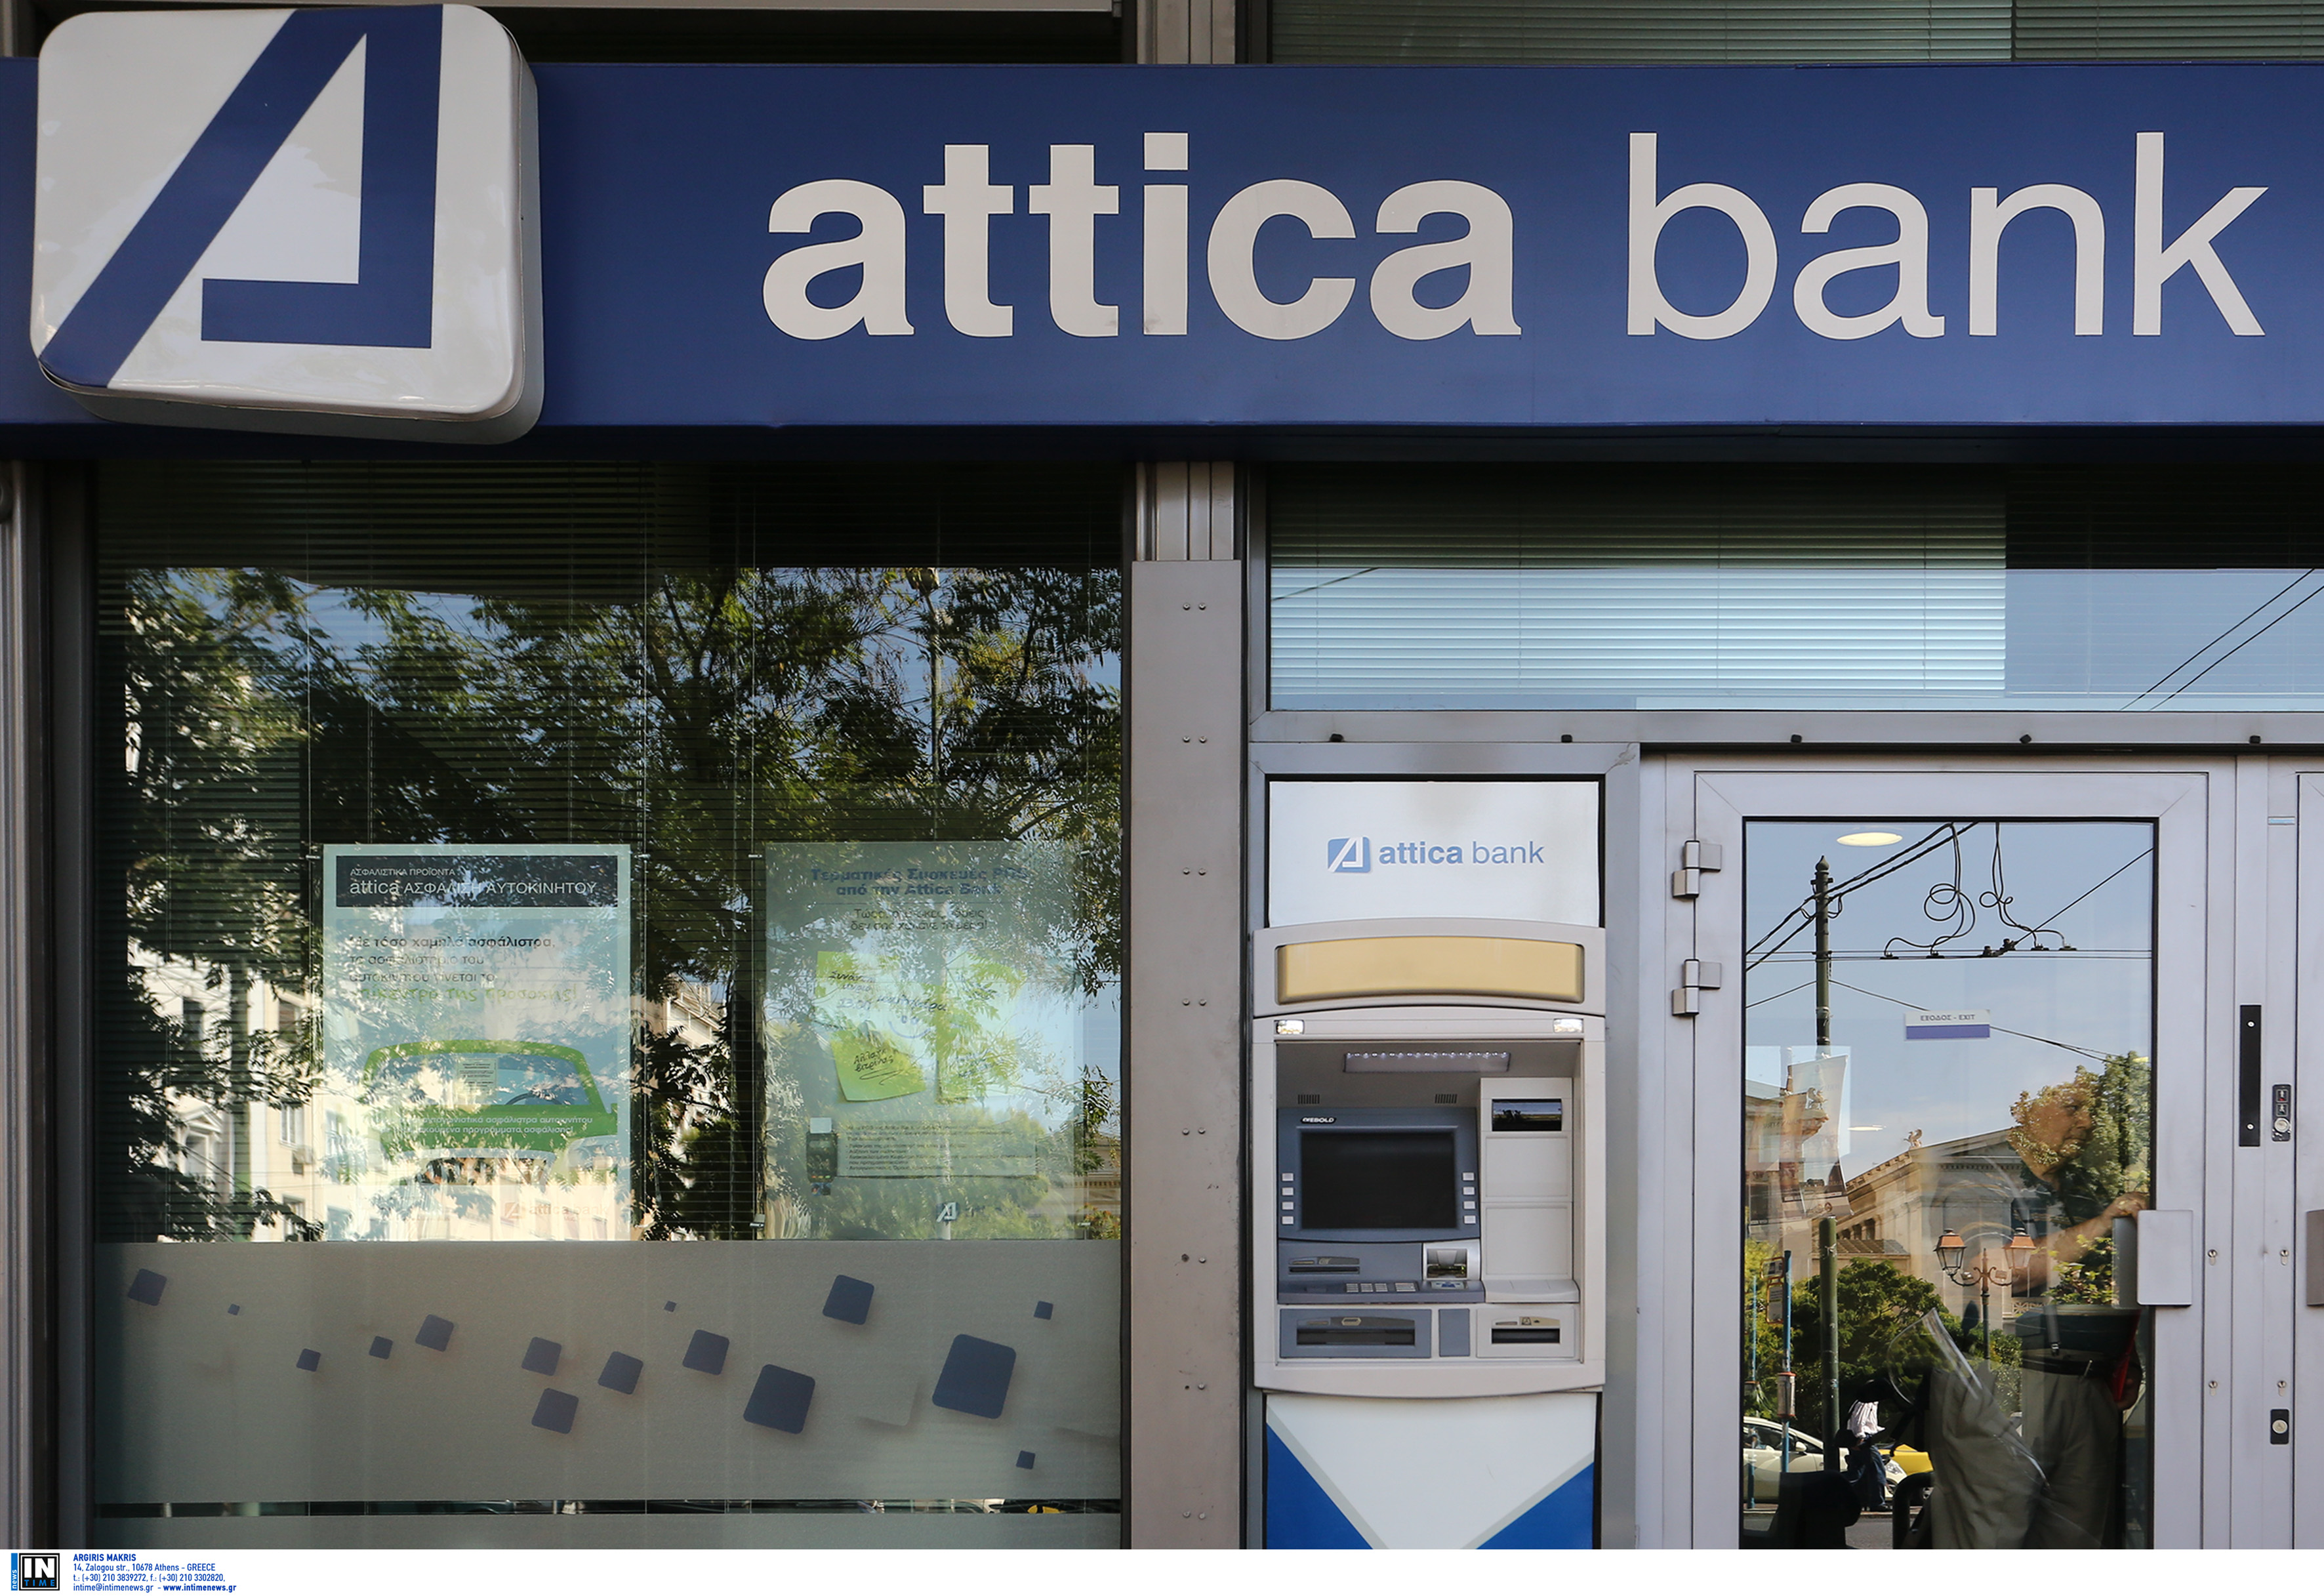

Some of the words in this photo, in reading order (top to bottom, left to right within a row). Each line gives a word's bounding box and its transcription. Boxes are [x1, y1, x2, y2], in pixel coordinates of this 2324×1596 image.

[763, 132, 1522, 340] attica
[1627, 132, 2269, 340] bank
[1379, 841, 1463, 865] attica
[1473, 840, 1544, 864] bank
[350, 880, 399, 893] attica
[403, 882, 481, 893] ΑΣΦΑΛΙΣΗ
[486, 882, 597, 893] ΑΥΤΟΚΙΝΗΤΟΥ
[836, 884, 868, 895] από
[374, 936, 407, 947] τόσο
[468, 936, 556, 949] ασφάλιστρα,
[462, 956, 484, 965] του
[350, 983, 439, 1003] πίκεντρο
[446, 987, 479, 1002] της
[486, 1116, 538, 1125] ασφάλιστρα
